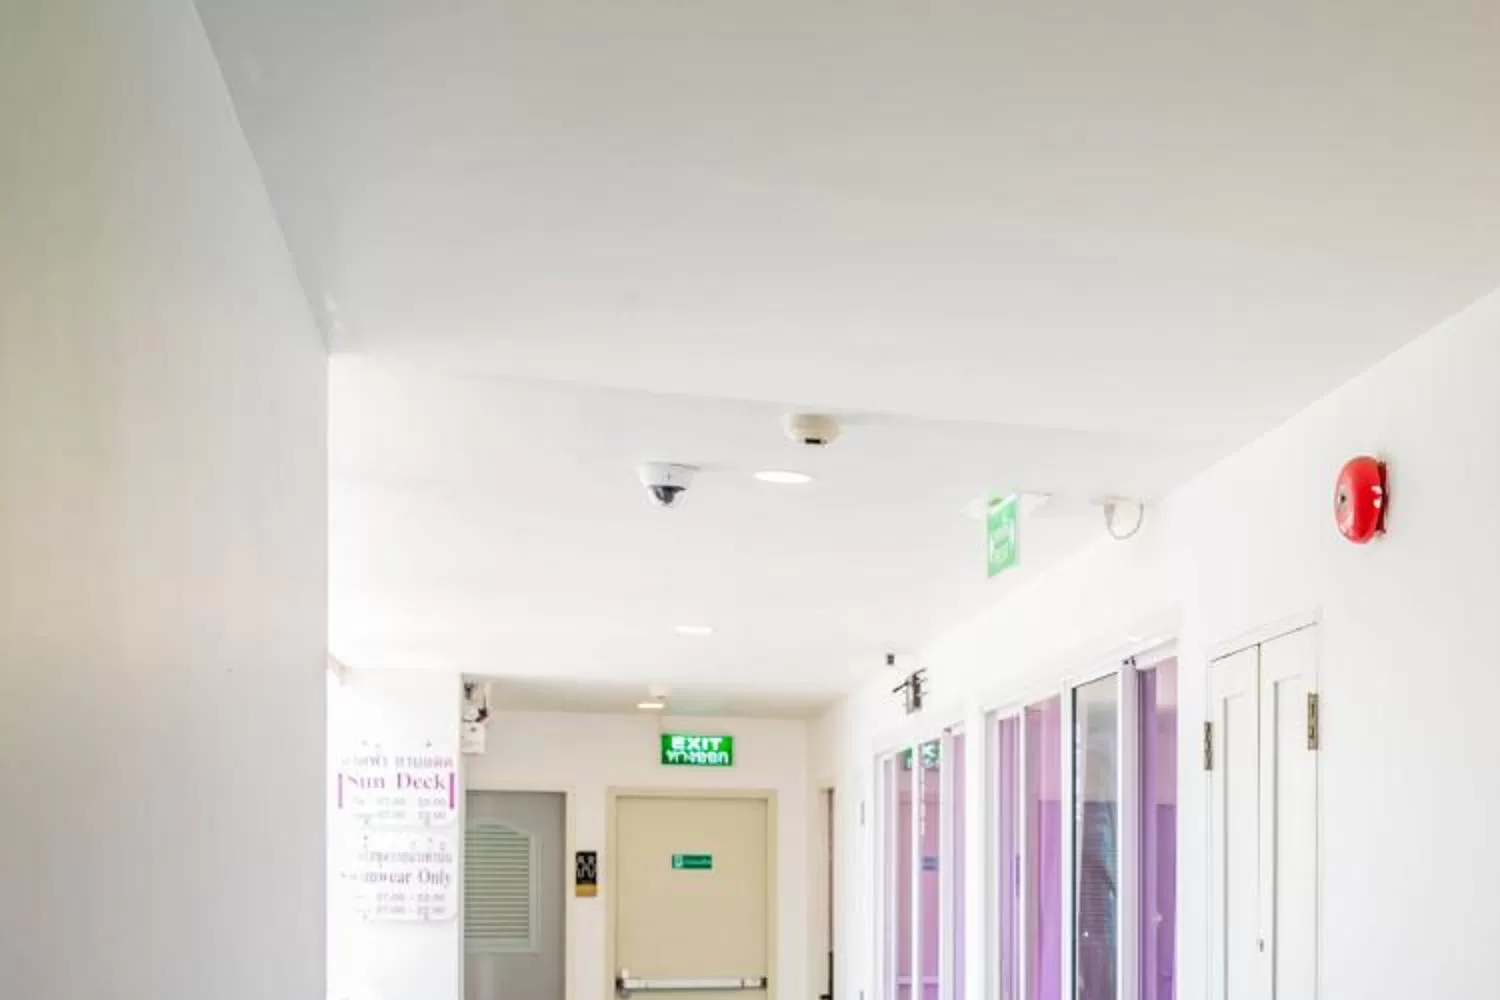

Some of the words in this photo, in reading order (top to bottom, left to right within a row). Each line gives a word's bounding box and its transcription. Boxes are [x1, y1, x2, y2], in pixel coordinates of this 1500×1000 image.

[671, 735, 723, 751] EXIT
[347, 774, 385, 790] Sun
[396, 772, 446, 790] Deck
[417, 866, 452, 889] Only
